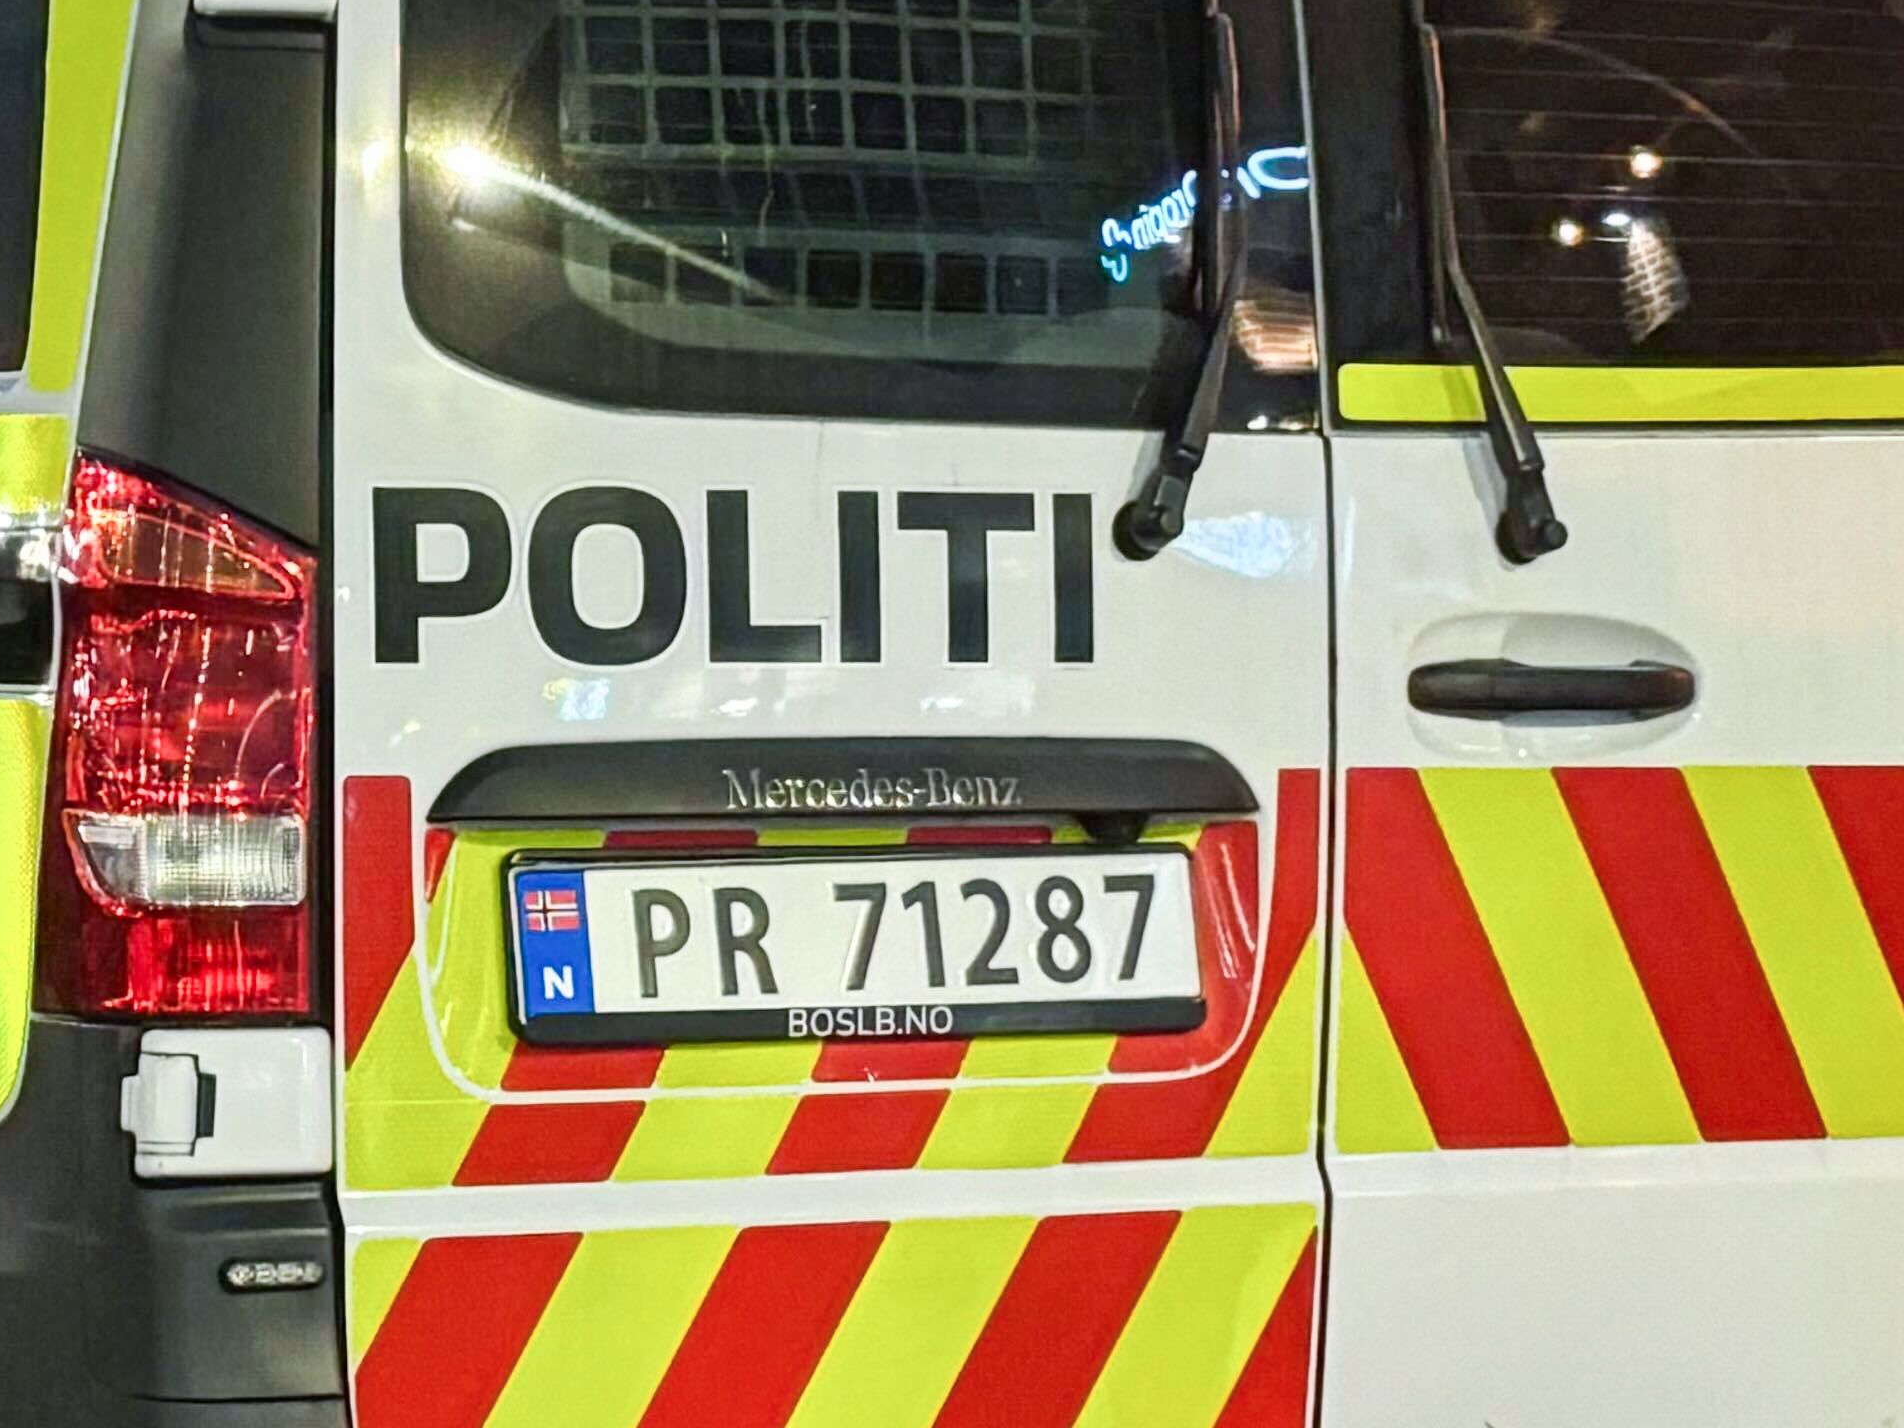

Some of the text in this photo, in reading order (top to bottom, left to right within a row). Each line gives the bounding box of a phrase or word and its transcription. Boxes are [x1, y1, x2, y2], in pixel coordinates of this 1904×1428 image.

[371, 485, 1095, 666] POLITI
[721, 767, 1023, 810] Mercedes-Benz
[631, 873, 1156, 999] PR 71287
[543, 966, 573, 1000] N
[787, 1005, 954, 1038] BOSLB.NO
